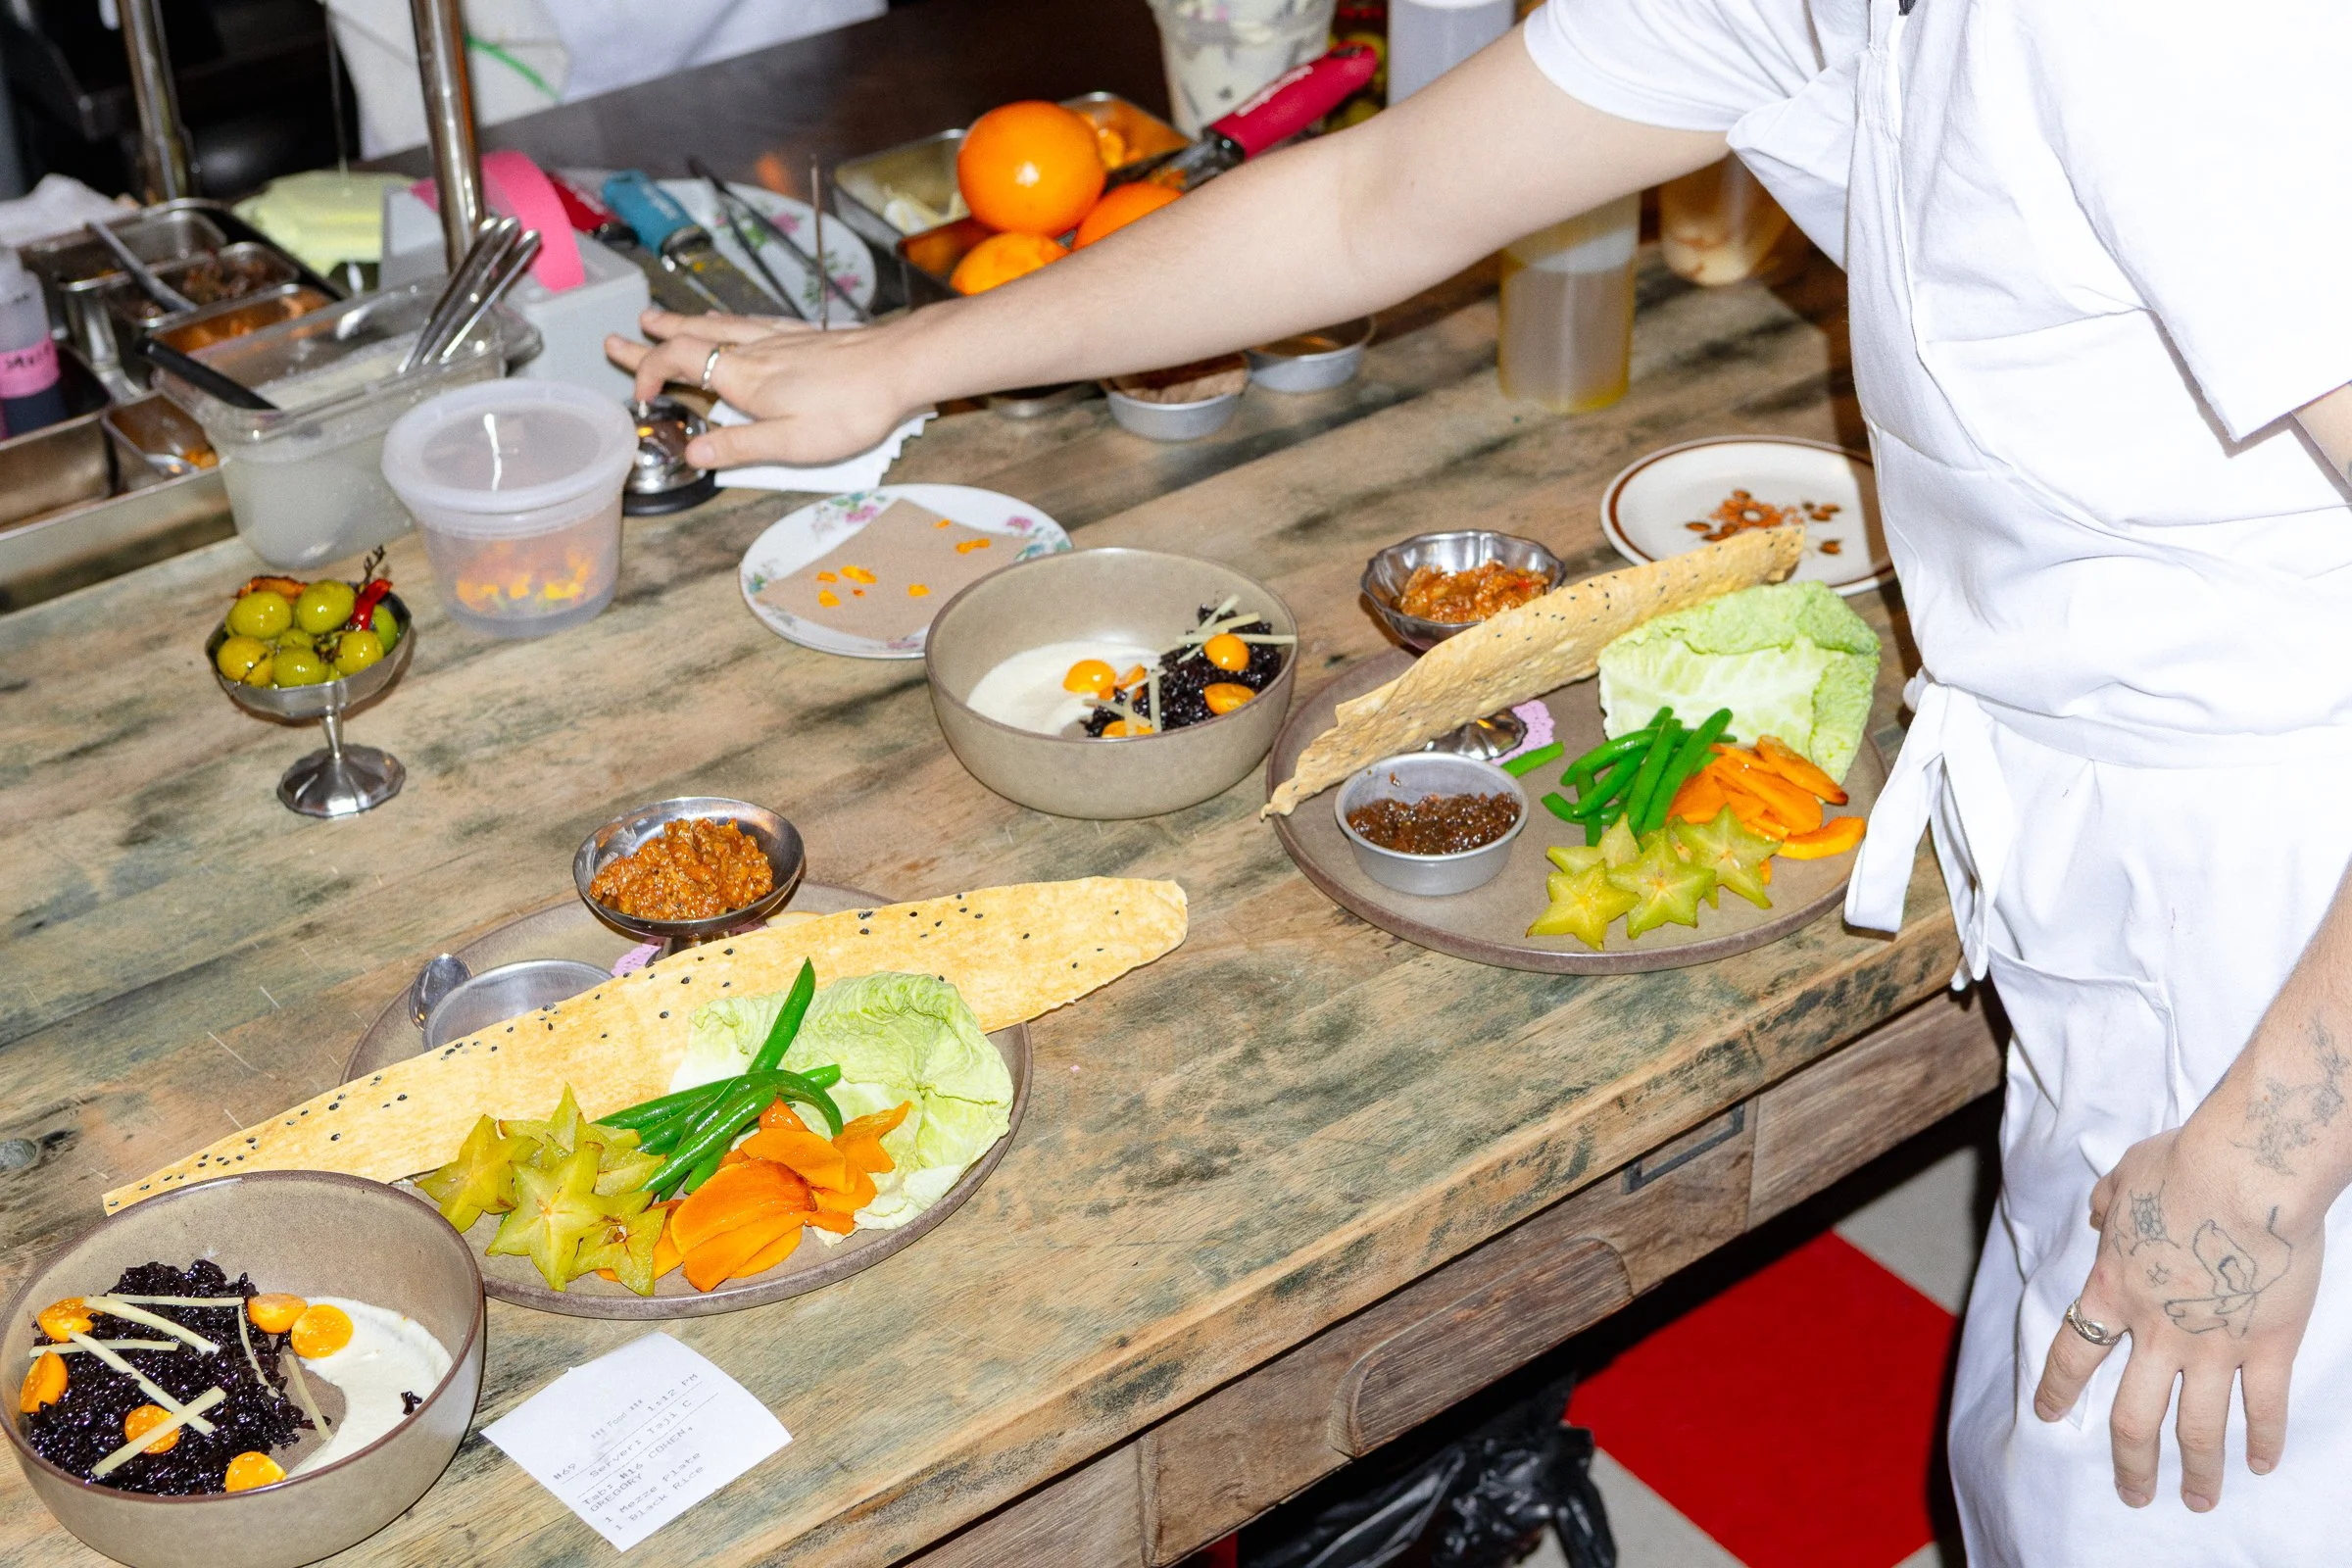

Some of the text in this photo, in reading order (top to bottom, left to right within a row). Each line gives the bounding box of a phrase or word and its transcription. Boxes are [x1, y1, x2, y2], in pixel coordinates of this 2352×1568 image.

[606, 1411, 627, 1428] Food
[647, 1389, 676, 1412] 1:12
[680, 1373, 699, 1388] PM
[581, 1482, 613, 1505] Tab:
[647, 1426, 694, 1459] COHEN,
[589, 1439, 643, 1479] Server:
[681, 1399, 693, 1408] C
[589, 1472, 643, 1513] GREGORY
[618, 1485, 659, 1514] Mezze
[662, 1449, 701, 1483] Plate
[627, 1493, 668, 1522] Black
[671, 1465, 705, 1491] Rice
